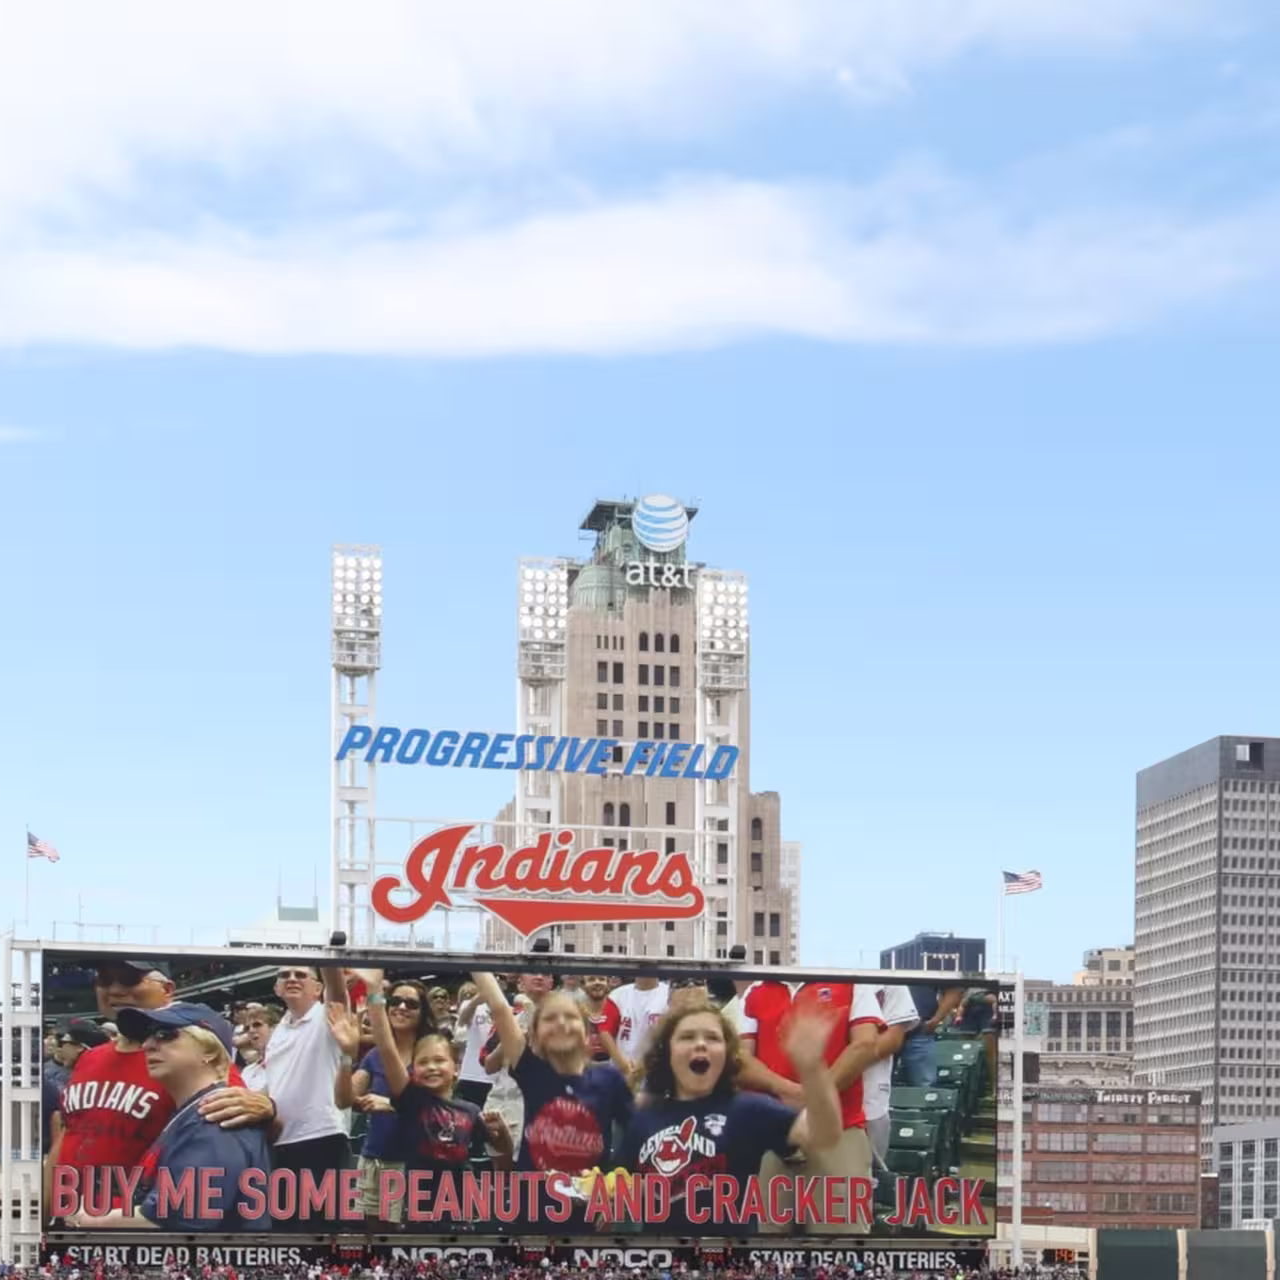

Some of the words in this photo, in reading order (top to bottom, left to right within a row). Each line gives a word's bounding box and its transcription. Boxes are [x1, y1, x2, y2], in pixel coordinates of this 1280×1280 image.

[625, 561, 696, 590] at&t
[336, 725, 620, 775] PROGRESSIVE
[624, 739, 740, 781] FIELD
[370, 824, 705, 926] Indians
[60, 1080, 160, 1121] INDIANS
[51, 1164, 144, 1219] BUY
[156, 1166, 226, 1220] ME
[237, 1167, 368, 1222] SOME
[378, 1170, 573, 1223] PEANUTS
[584, 1173, 671, 1224] AND
[685, 1174, 874, 1225] CRACKER
[883, 1176, 988, 1226] JACK
[68, 1247, 135, 1265] START
[136, 1247, 189, 1265] DEAD
[391, 1248, 494, 1265] NOCO
[574, 1248, 672, 1268] NOCO
